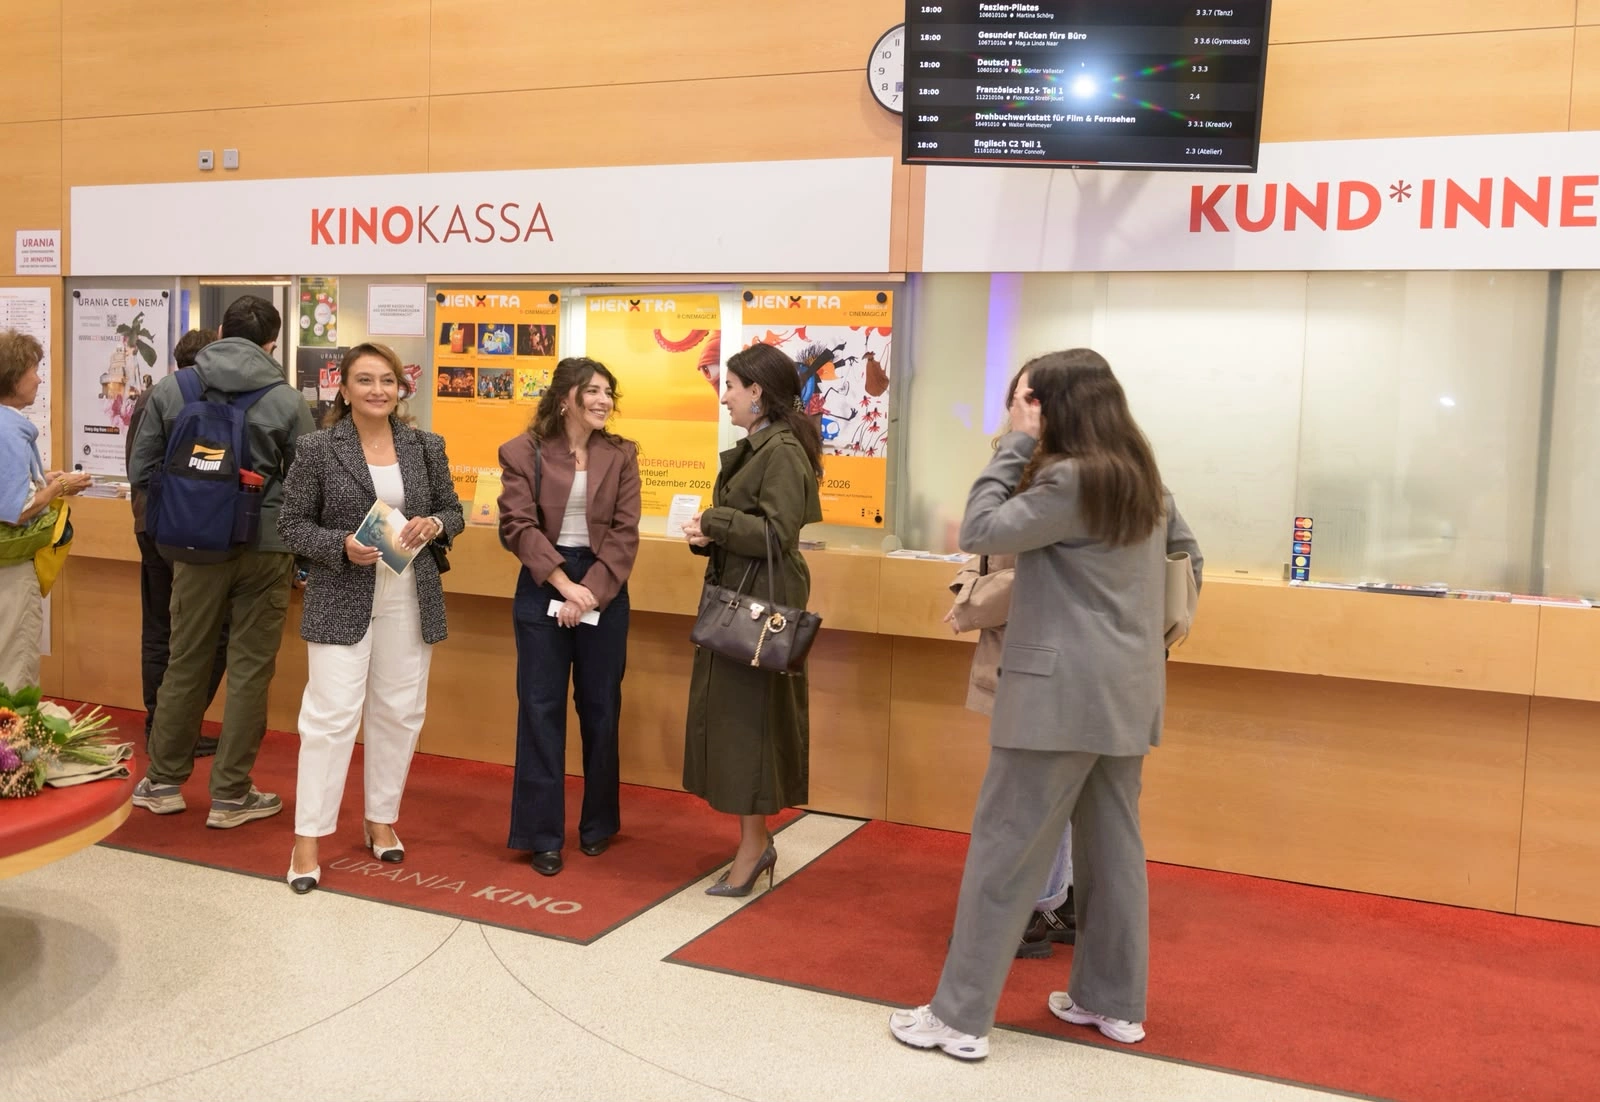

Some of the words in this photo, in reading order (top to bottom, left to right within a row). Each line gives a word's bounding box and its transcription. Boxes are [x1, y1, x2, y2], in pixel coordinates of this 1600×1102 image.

[979, 3, 1039, 11] Faszien-Pilates
[1214, 9, 1233, 17] (Tanz)
[978, 31, 1017, 39] Gesunder
[1018, 31, 1047, 39] Rücken
[1049, 32, 1065, 40] fürs
[1067, 32, 1087, 40] Büro
[1211, 38, 1251, 46] (Gymnastik)
[882, 51, 892, 59] 10
[977, 58, 1009, 66] Deutsch
[879, 67, 885, 75] 9
[881, 83, 888, 91] 8
[976, 85, 1022, 94] Französisch
[1024, 86, 1040, 94] B2+
[1042, 86, 1057, 94] Teil
[1058, 87, 1063, 95] 1
[892, 94, 899, 103] 7
[975, 113, 1051, 121] Drehbuchwerkstatt
[1052, 113, 1065, 122] für
[1066, 114, 1083, 123] Film
[1085, 115, 1092, 123] &
[1093, 115, 1136, 124] Fernsehen
[974, 140, 1007, 148] Englisch
[1008, 140, 1019, 148] C2
[1020, 140, 1034, 148] Teil
[1036, 140, 1042, 148] 1
[311, 202, 554, 245] KINOKASSA
[22, 238, 55, 247] URANIA
[78, 298, 109, 307] URANIA
[590, 299, 676, 312] WIENXTRA
[188, 456, 222, 471] PUMA
[639, 458, 706, 469] NDERGRUPPEN
[645, 478, 688, 488] Dezember
[689, 480, 711, 489] 2026
[827, 480, 851, 489] 2026
[329, 858, 467, 894] URANIA
[471, 886, 583, 915] KINO
